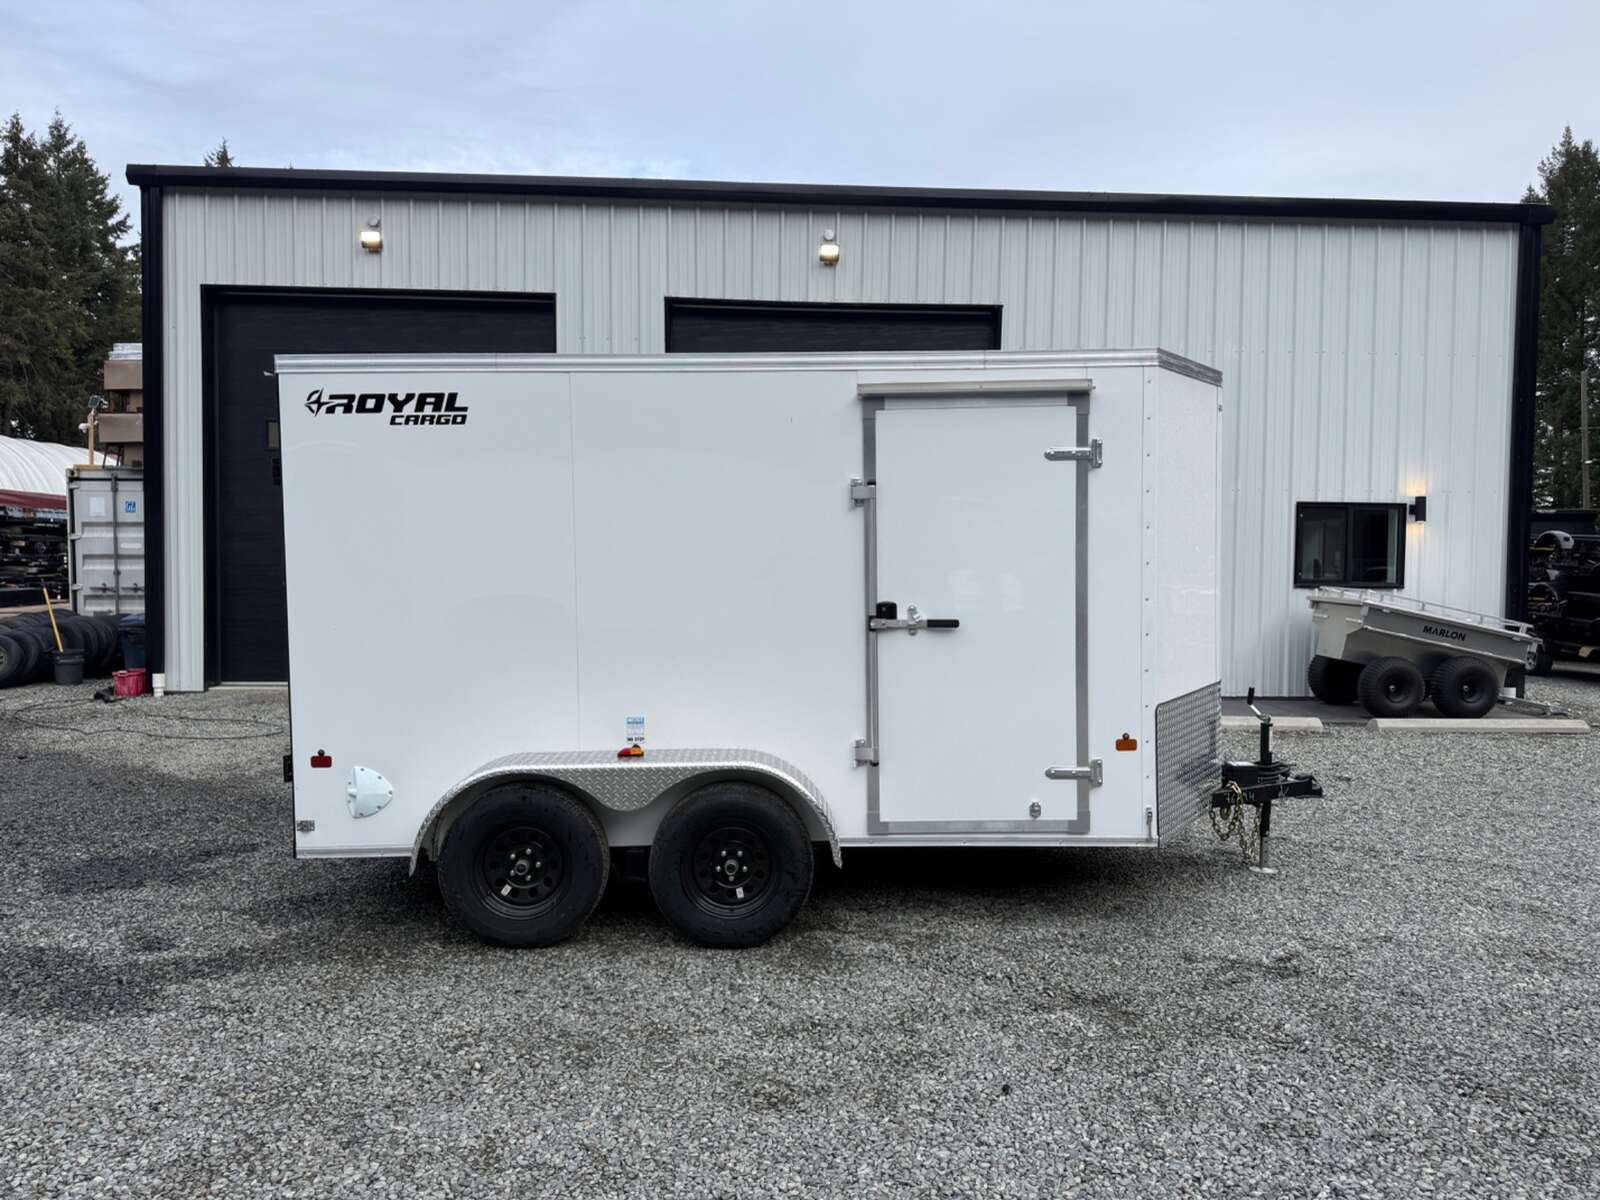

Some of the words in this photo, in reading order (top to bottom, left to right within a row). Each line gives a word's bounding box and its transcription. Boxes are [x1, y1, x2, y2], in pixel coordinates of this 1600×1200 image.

[325, 392, 468, 414] ROYAL
[389, 414, 467, 426] CARGO
[1423, 625, 1466, 641] MARLON
